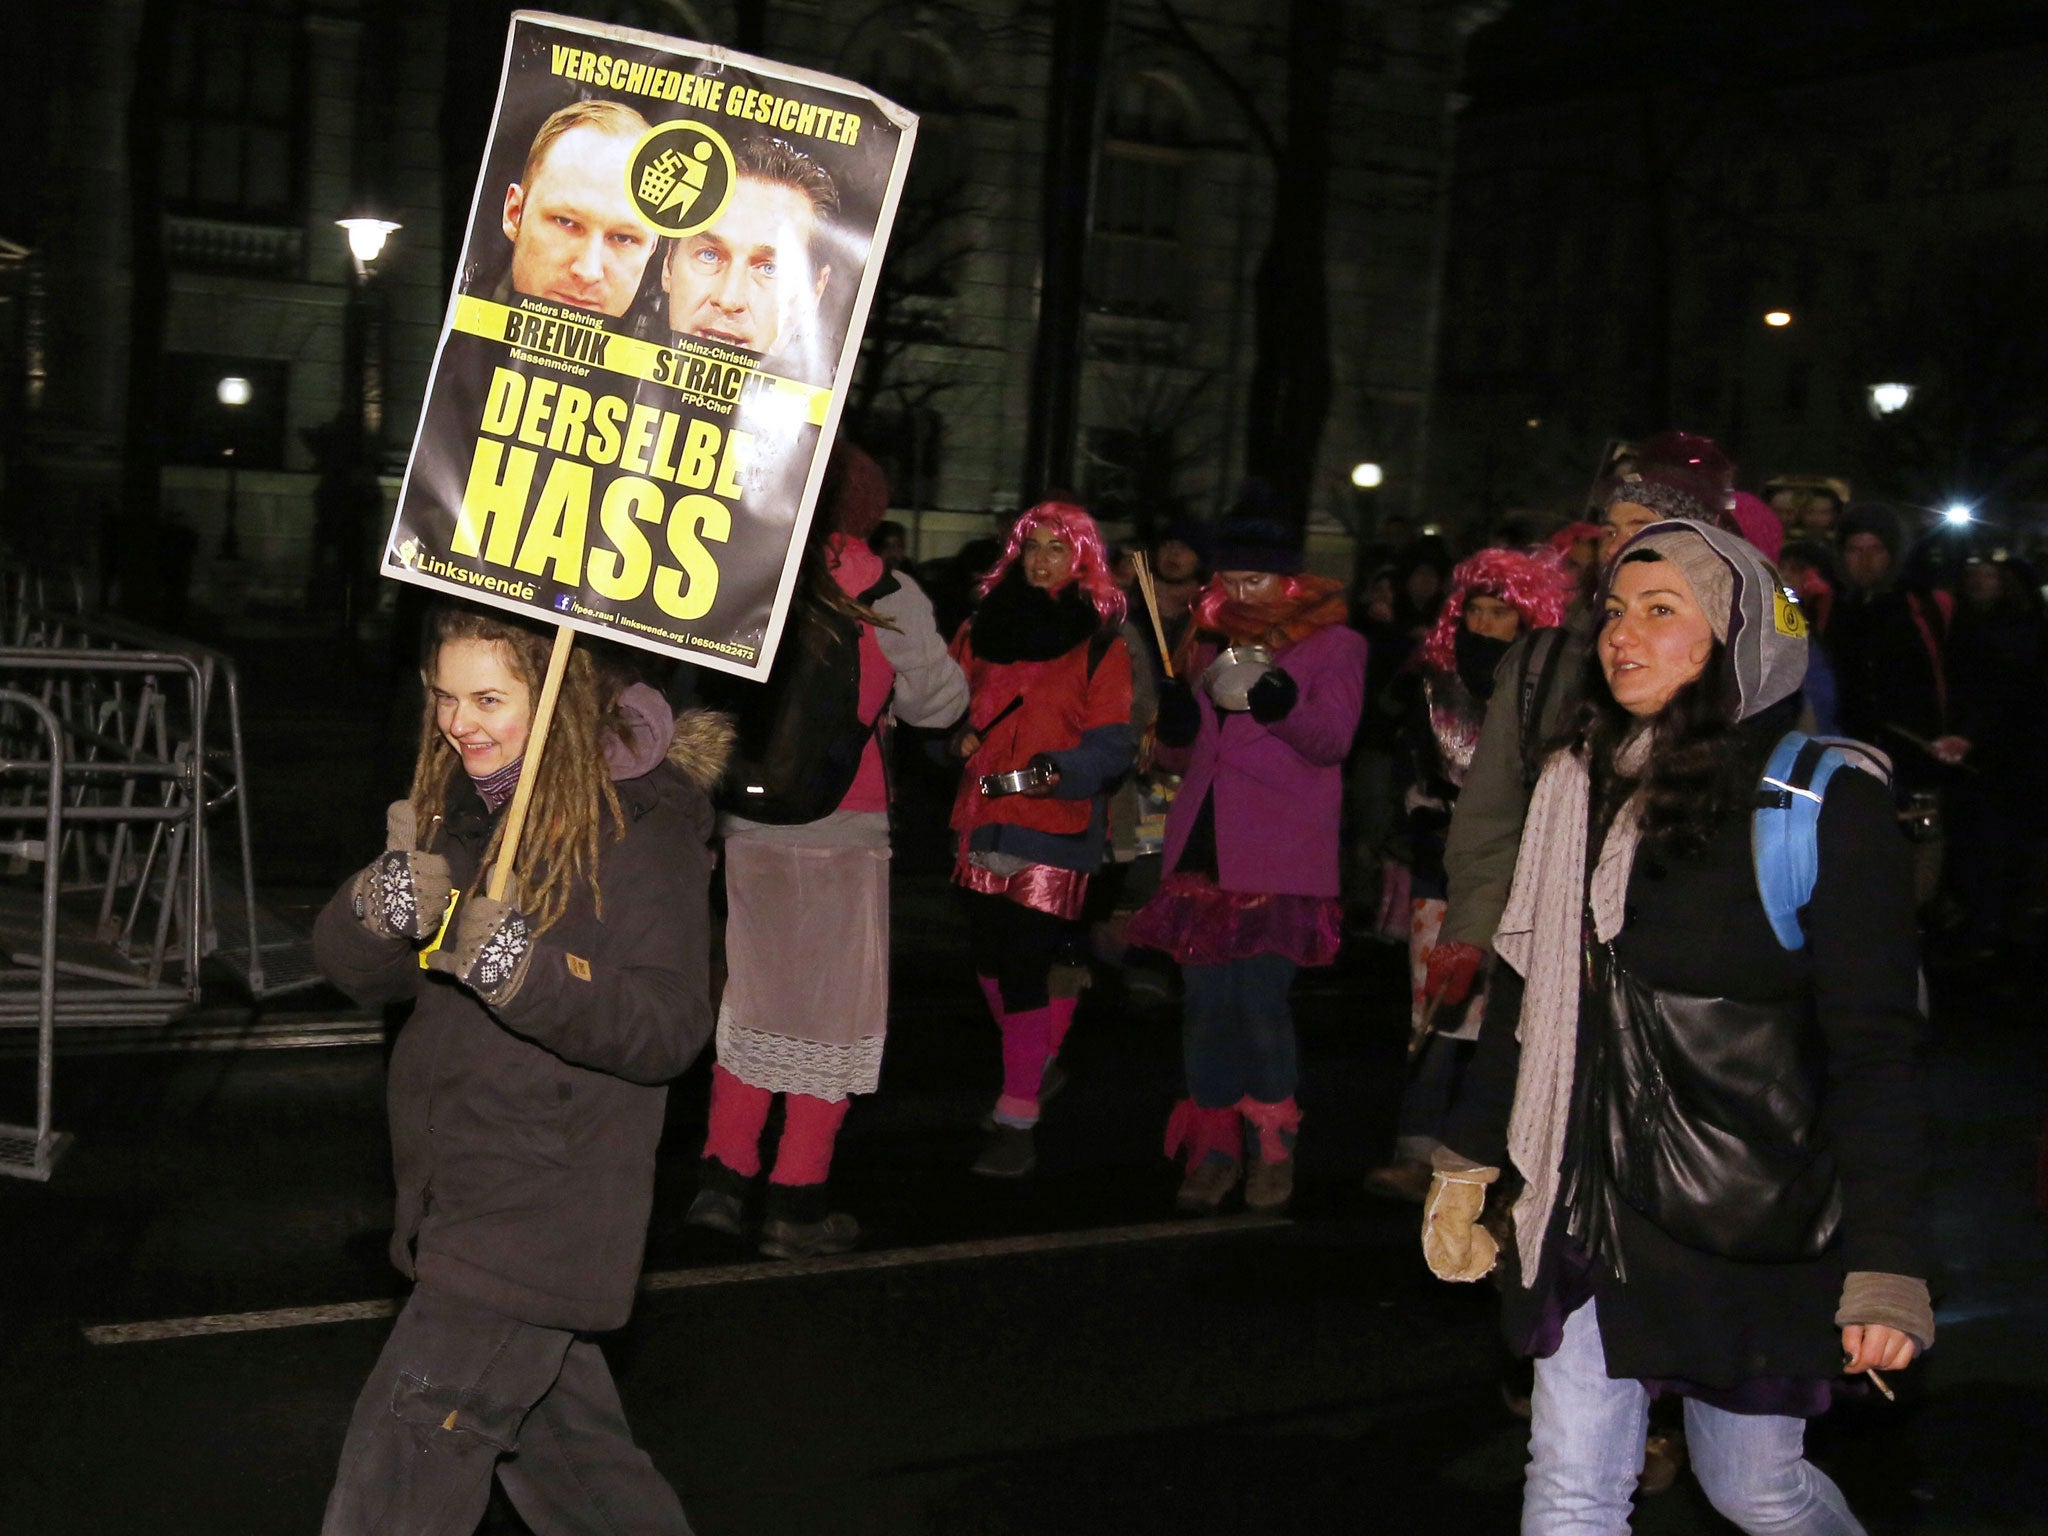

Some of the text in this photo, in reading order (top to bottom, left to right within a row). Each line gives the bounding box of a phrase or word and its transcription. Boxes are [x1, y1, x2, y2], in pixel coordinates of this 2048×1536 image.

[551, 45, 861, 146] VERSCHIEDENE GESICHTER
[520, 299, 604, 329] Anders Behring
[504, 311, 611, 366] BREIVIK
[678, 339, 761, 369] Heinz-Christian
[510, 348, 590, 377] Massenmörder
[681, 393, 733, 415] FPÖ-Chef
[480, 366, 755, 500] DERSELBE
[450, 436, 732, 620] HASS
[417, 553, 534, 600] Linkswende
[620, 616, 684, 643] linkswende.org
[690, 636, 754, 660] 06504522473
